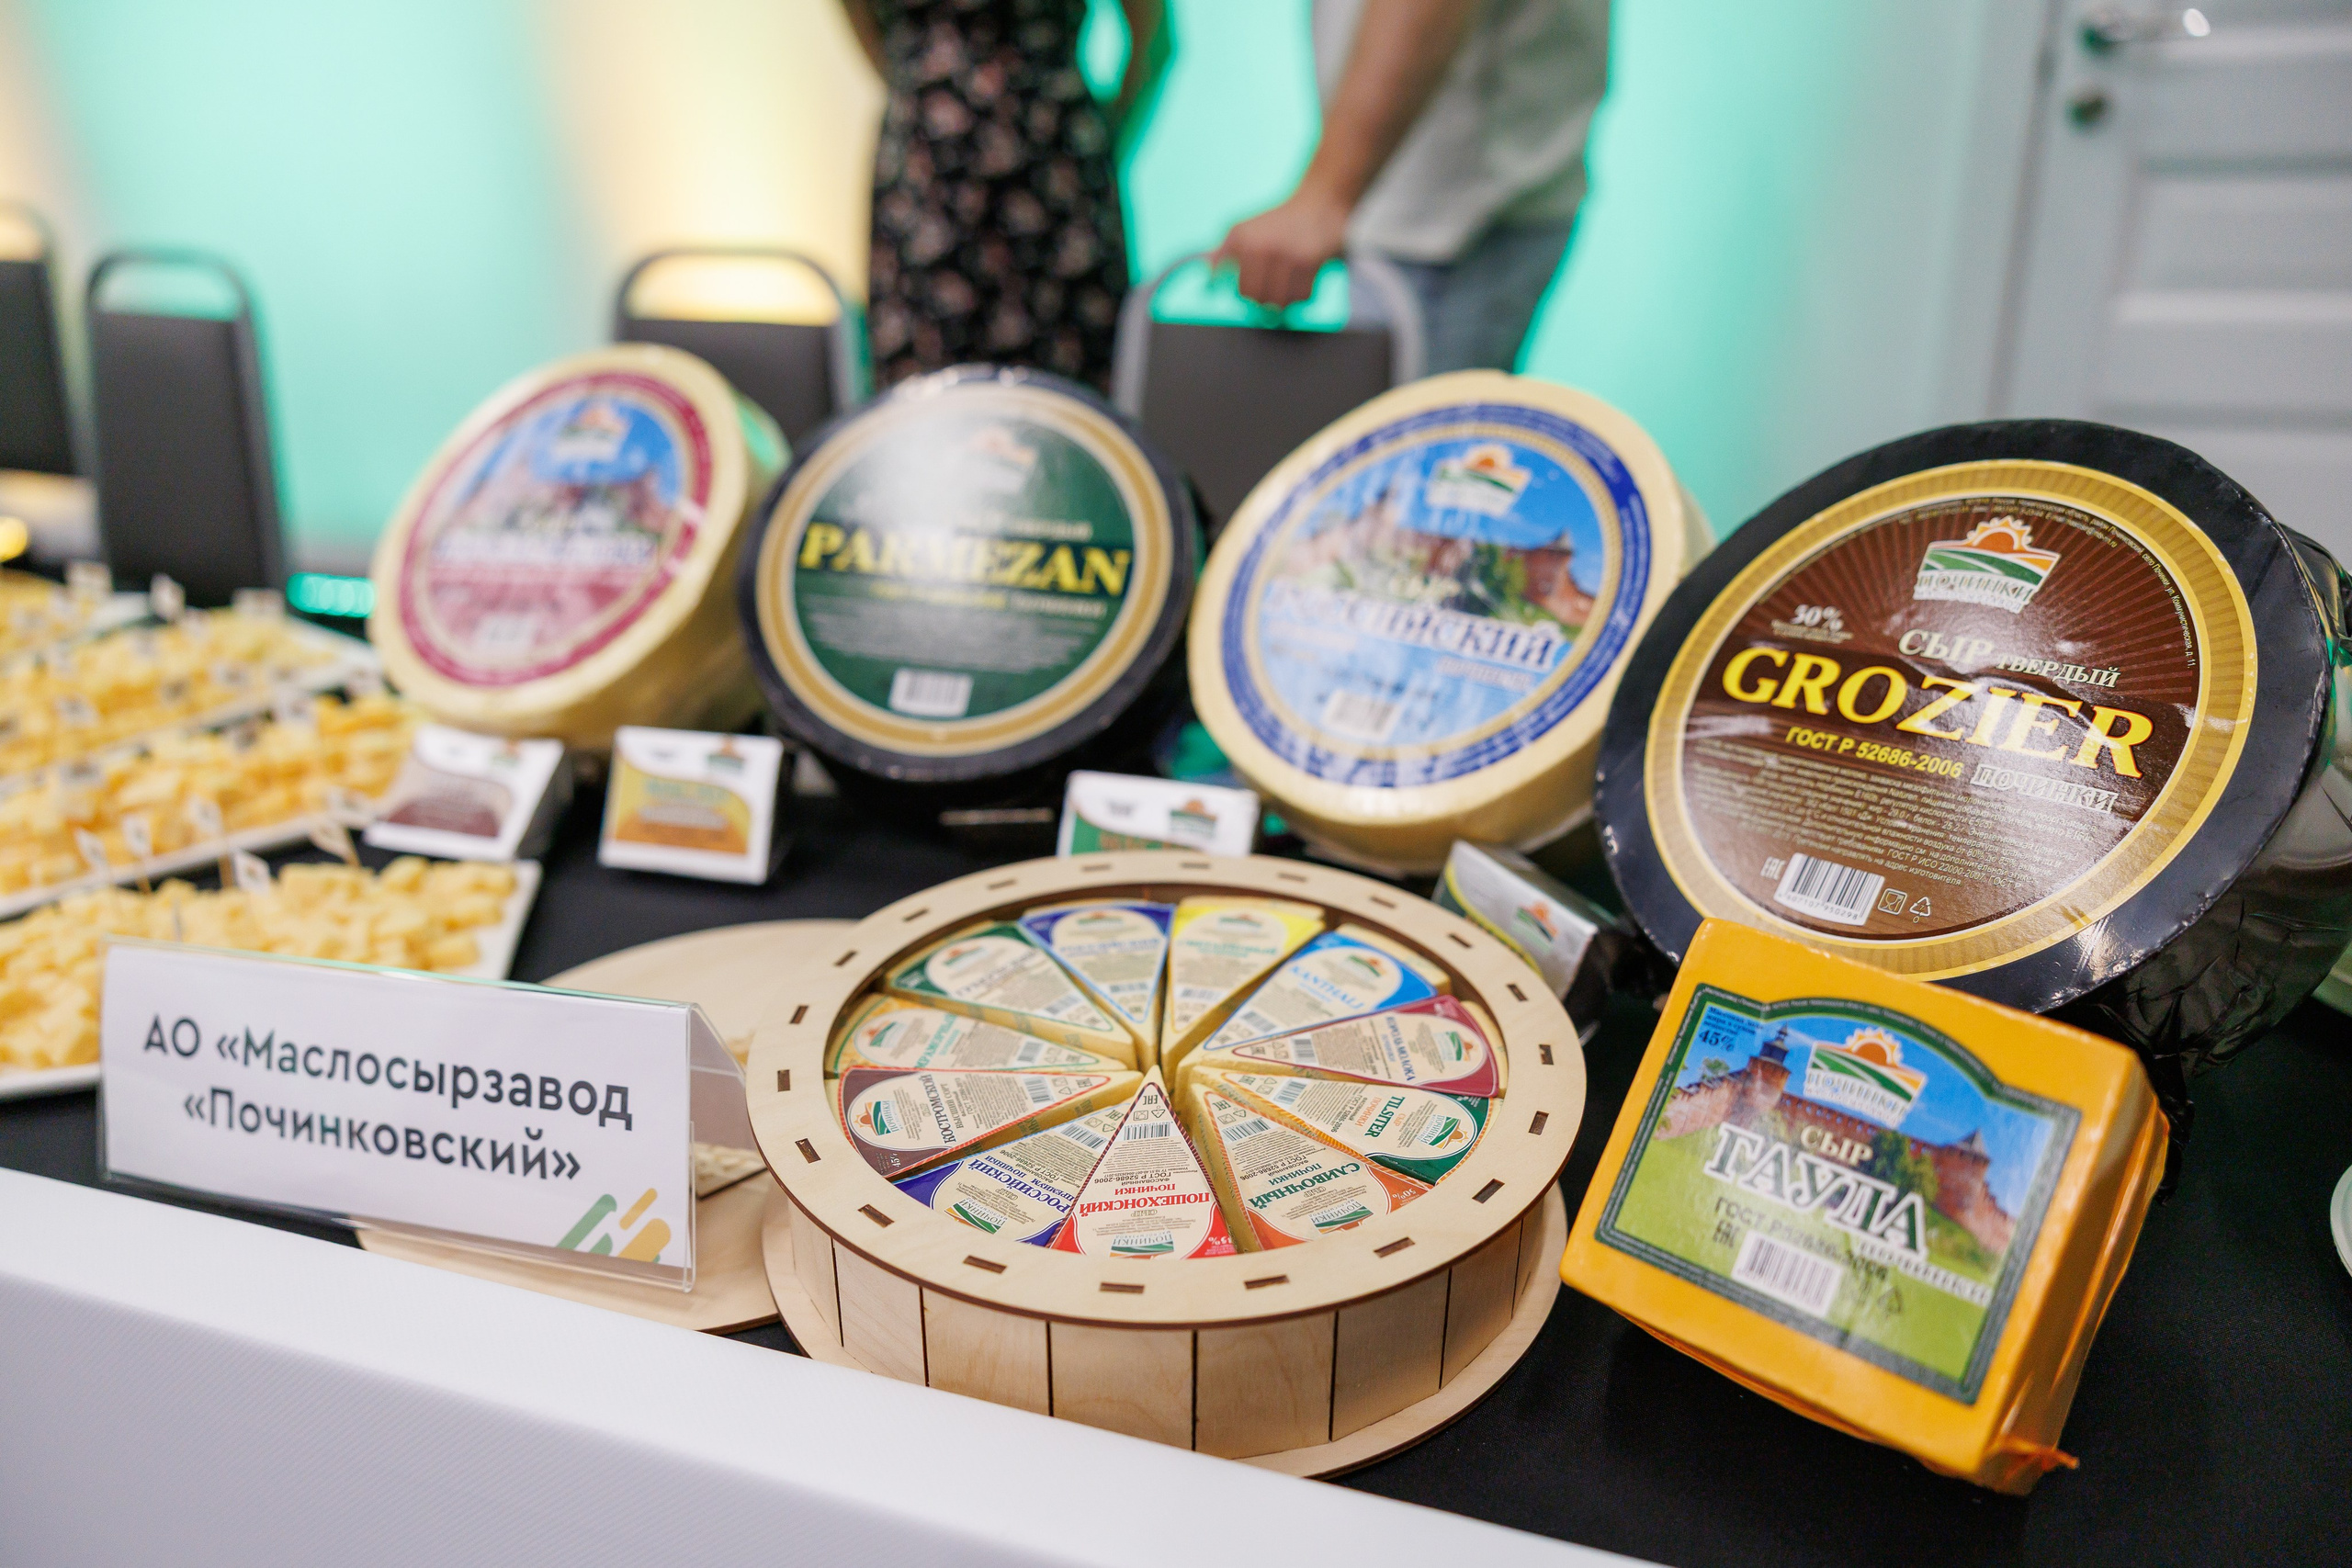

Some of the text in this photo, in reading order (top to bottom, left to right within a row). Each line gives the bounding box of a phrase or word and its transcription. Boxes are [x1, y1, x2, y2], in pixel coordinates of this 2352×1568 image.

[798, 522, 1131, 595] PARMEZAN
[1917, 574, 2034, 603] ПОЧИНКИ
[2143, 553, 2154, 567] село
[2165, 586, 2175, 597] ул.
[2171, 594, 2193, 651] Коммунистическая,
[1898, 628, 1994, 664] СЫР
[1996, 653, 2120, 688] ТВЕРДЫЙ
[1722, 646, 2154, 781] GROZIER
[1785, 727, 1965, 779] ГОСТ Р 52686-2006
[1971, 763, 2118, 814] ПОЧИНКИ
[1922, 837, 1955, 853] воздуха
[1955, 845, 1965, 854] от
[1965, 846, 1985, 860] 80%
[1883, 859, 1908, 874] адрес
[1886, 847, 1911, 862] ГОСТ
[1909, 852, 1918, 863] Р
[1917, 855, 1939, 869] ИСО
[1987, 873, 2015, 889] ГОСТ
[1928, 850, 1939, 859] на
[1939, 852, 2007, 876] дополнительной
[1699, 1029, 1736, 1052] 45%
[143, 1014, 633, 1131] АО «Маслосырзавод
[919, 1074, 957, 1145] КОСТРОМСКОЙ
[941, 1083, 965, 1129] ВЫСШИЙ СОРТ
[1143, 1095, 1159, 1106] EAC
[1217, 1100, 1231, 1111] EAC
[1356, 1096, 1383, 1127] ПОЧИНКИ
[883, 1100, 899, 1133] ПОЧИНКИ
[1105, 1110, 1125, 1121] EAC
[1364, 1096, 1405, 1138] TILSITER
[184, 1088, 581, 1180] «Починковский»
[1423, 1114, 1445, 1145] ПОЧИНКИ
[1800, 1125, 1872, 1168] СЫР
[984, 1155, 1027, 1179] ПОЧИНКИ
[1266, 1158, 1308, 1177] ФАСОВАННЫЙ
[1286, 1154, 1306, 1165] ГОСТ
[1015, 1163, 1054, 1184] ФАСОВАННЫЙ
[1040, 1168, 1060, 1181] ГОСТ
[1093, 1173, 1138, 1185] 52686-2006
[1120, 1176, 1170, 1187] ФАСОВАННЫЙ
[1148, 1170, 1171, 1179] ГОСТ
[1238, 1163, 1279, 1181] 52686-2006
[1269, 1162, 1322, 1186] ПОЧИНКИ
[968, 1159, 1071, 1213] РОССИЙСКИЙ
[995, 1189, 1019, 1201] СЫР
[1031, 1178, 1075, 1202] ПРЕМИУМ
[1114, 1184, 1176, 1195] ПОЧИНКИ
[1248, 1162, 1361, 1210] СЛИВОЧНЫЙ
[1304, 1186, 1327, 1197] СЫР
[1392, 1188, 1417, 1201] 50%
[1704, 1122, 1927, 1262] ГАУДА
[958, 1199, 1006, 1226] ПОЧИНКИ
[1080, 1193, 1210, 1217] ПОШЕХОНСКИЙ
[1131, 1209, 1158, 1217] СЫР
[1310, 1201, 1362, 1224] ПОЧИНКИ
[1714, 1196, 1766, 1228] ГОСТ
[1113, 1235, 1173, 1246] ПОЧИНКИ
